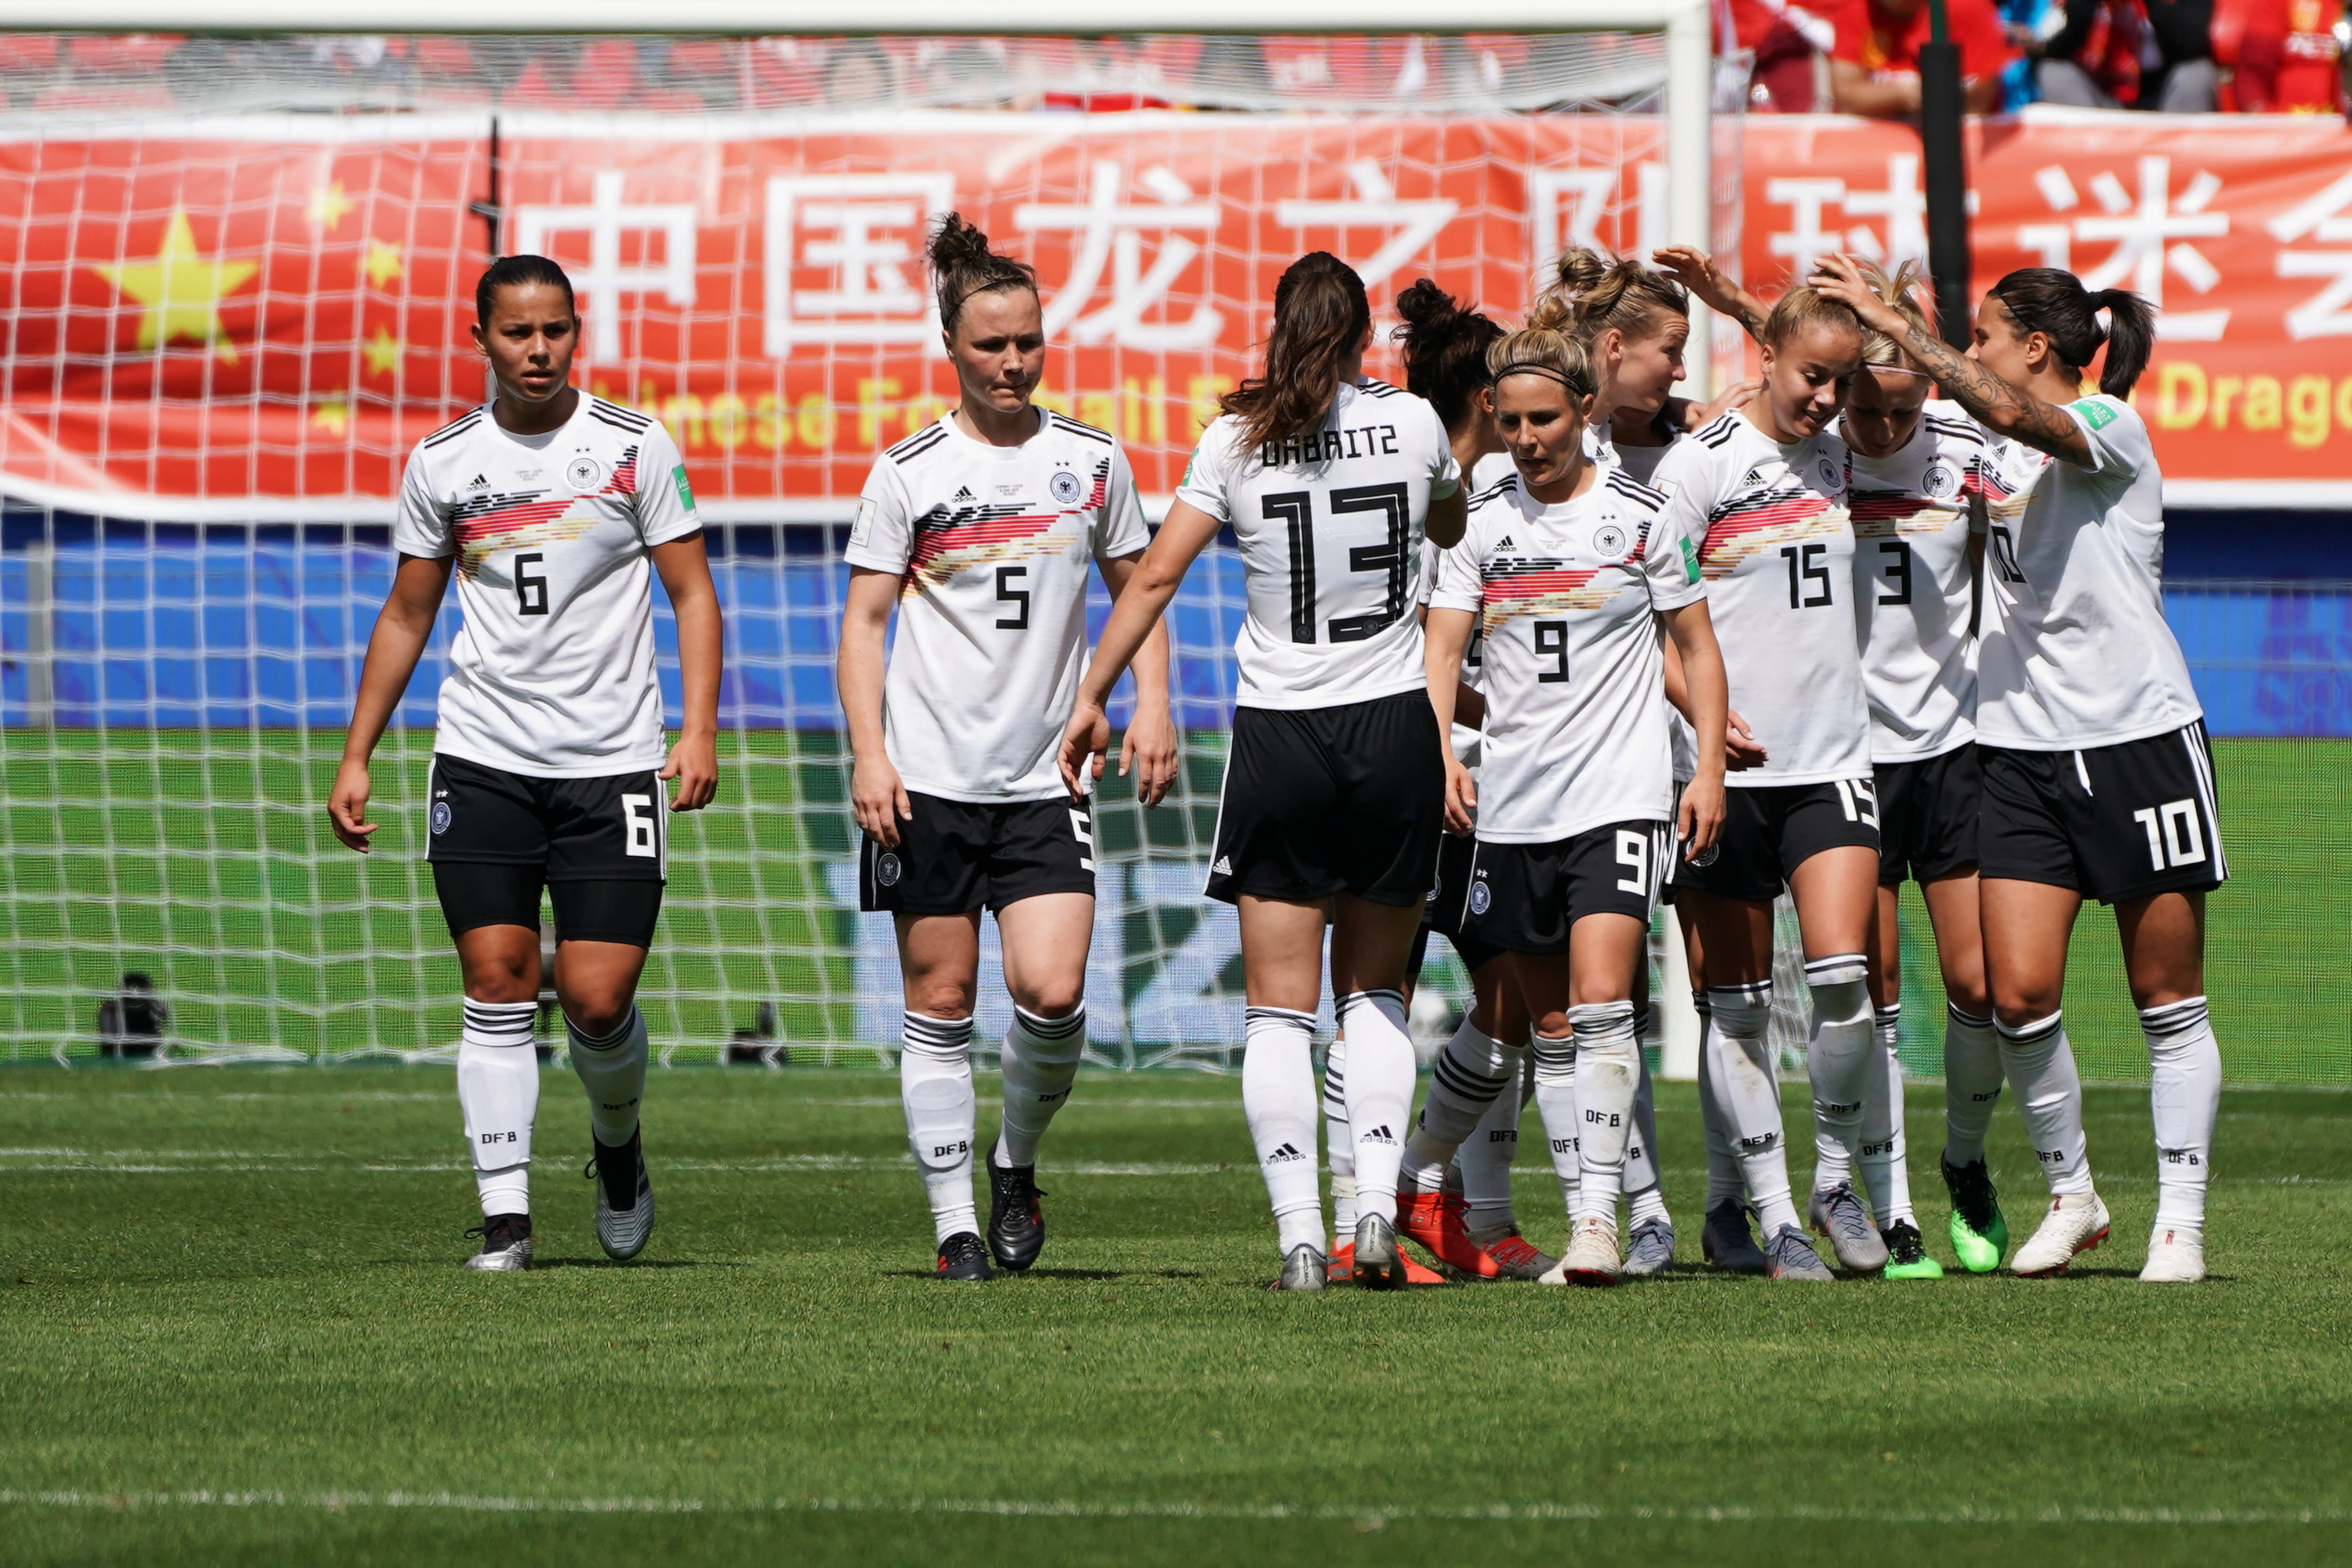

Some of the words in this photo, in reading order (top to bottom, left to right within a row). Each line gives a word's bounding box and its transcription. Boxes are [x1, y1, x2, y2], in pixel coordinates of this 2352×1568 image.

[858, 375, 1159, 446] Foall
[515, 552, 549, 615] 6
[1261, 481, 1410, 645] 13
[1780, 543, 1833, 609] 15
[1878, 541, 1912, 605] 3
[996, 566, 1030, 629] 5
[1534, 621, 1569, 683] 9
[621, 793, 657, 858] 6
[1836, 778, 1880, 832] 15
[2133, 798, 2206, 872] 10
[1068, 807, 1096, 874] 5
[1616, 829, 1648, 897] 9
[482, 1131, 516, 1144] DFB
[934, 1140, 968, 1158] DFB
[1359, 1135, 1398, 1146] adidas
[1586, 1109, 1621, 1127] DFB
[1863, 1140, 1893, 1156] DFB
[1265, 1153, 1307, 1165] adidas
[2169, 1151, 2199, 1165] DFB
